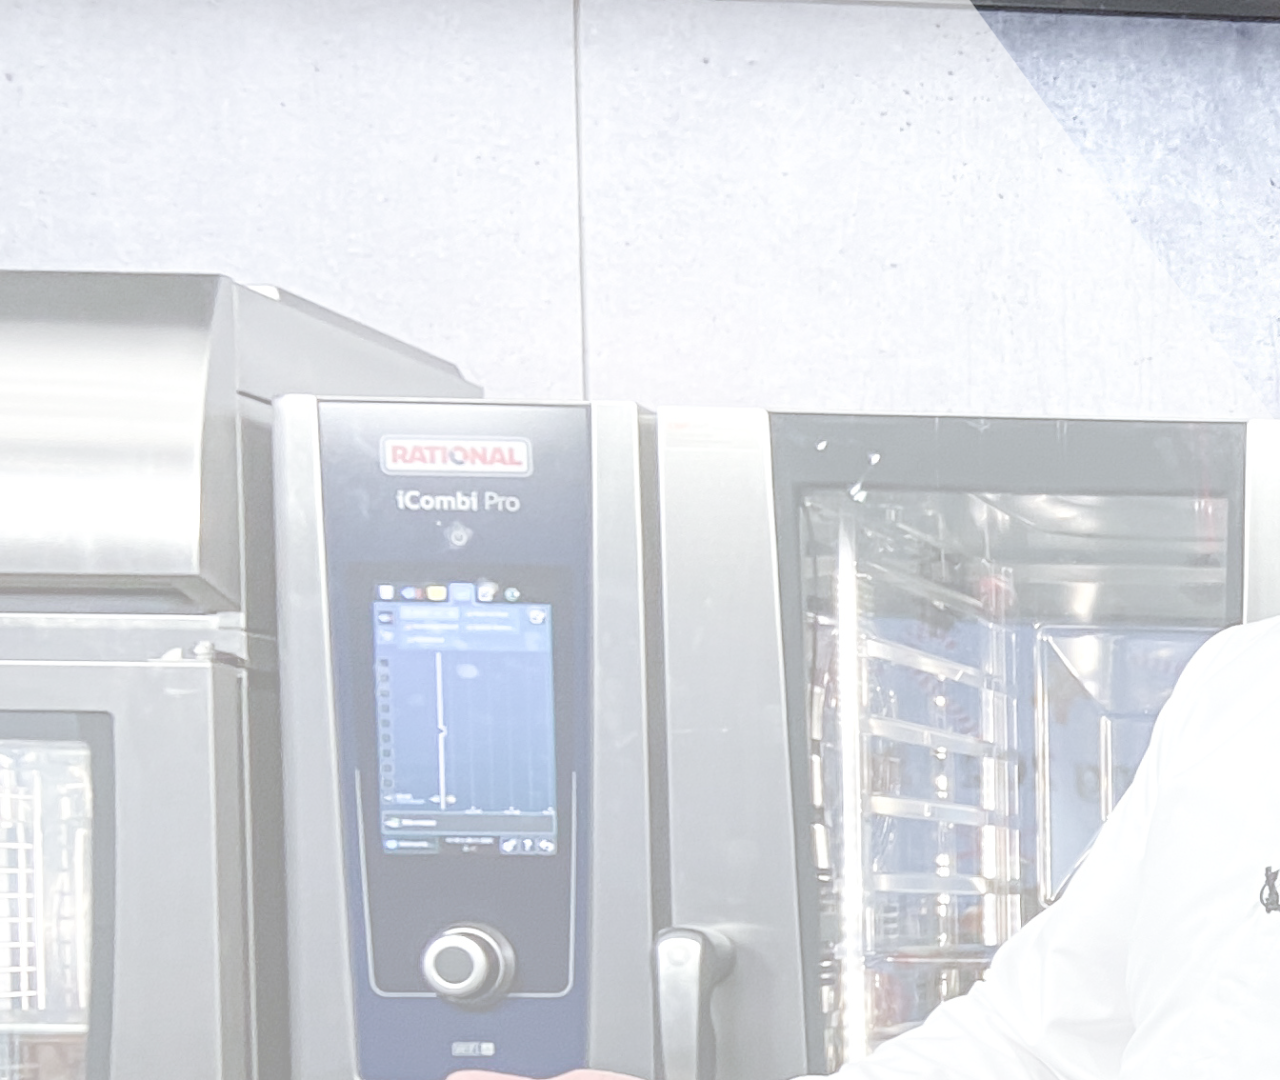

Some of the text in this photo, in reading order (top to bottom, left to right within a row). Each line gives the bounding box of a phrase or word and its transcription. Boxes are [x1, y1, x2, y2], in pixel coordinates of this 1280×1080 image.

[391, 444, 523, 467] RATIONAL
[396, 489, 521, 512] iCombi Pro
